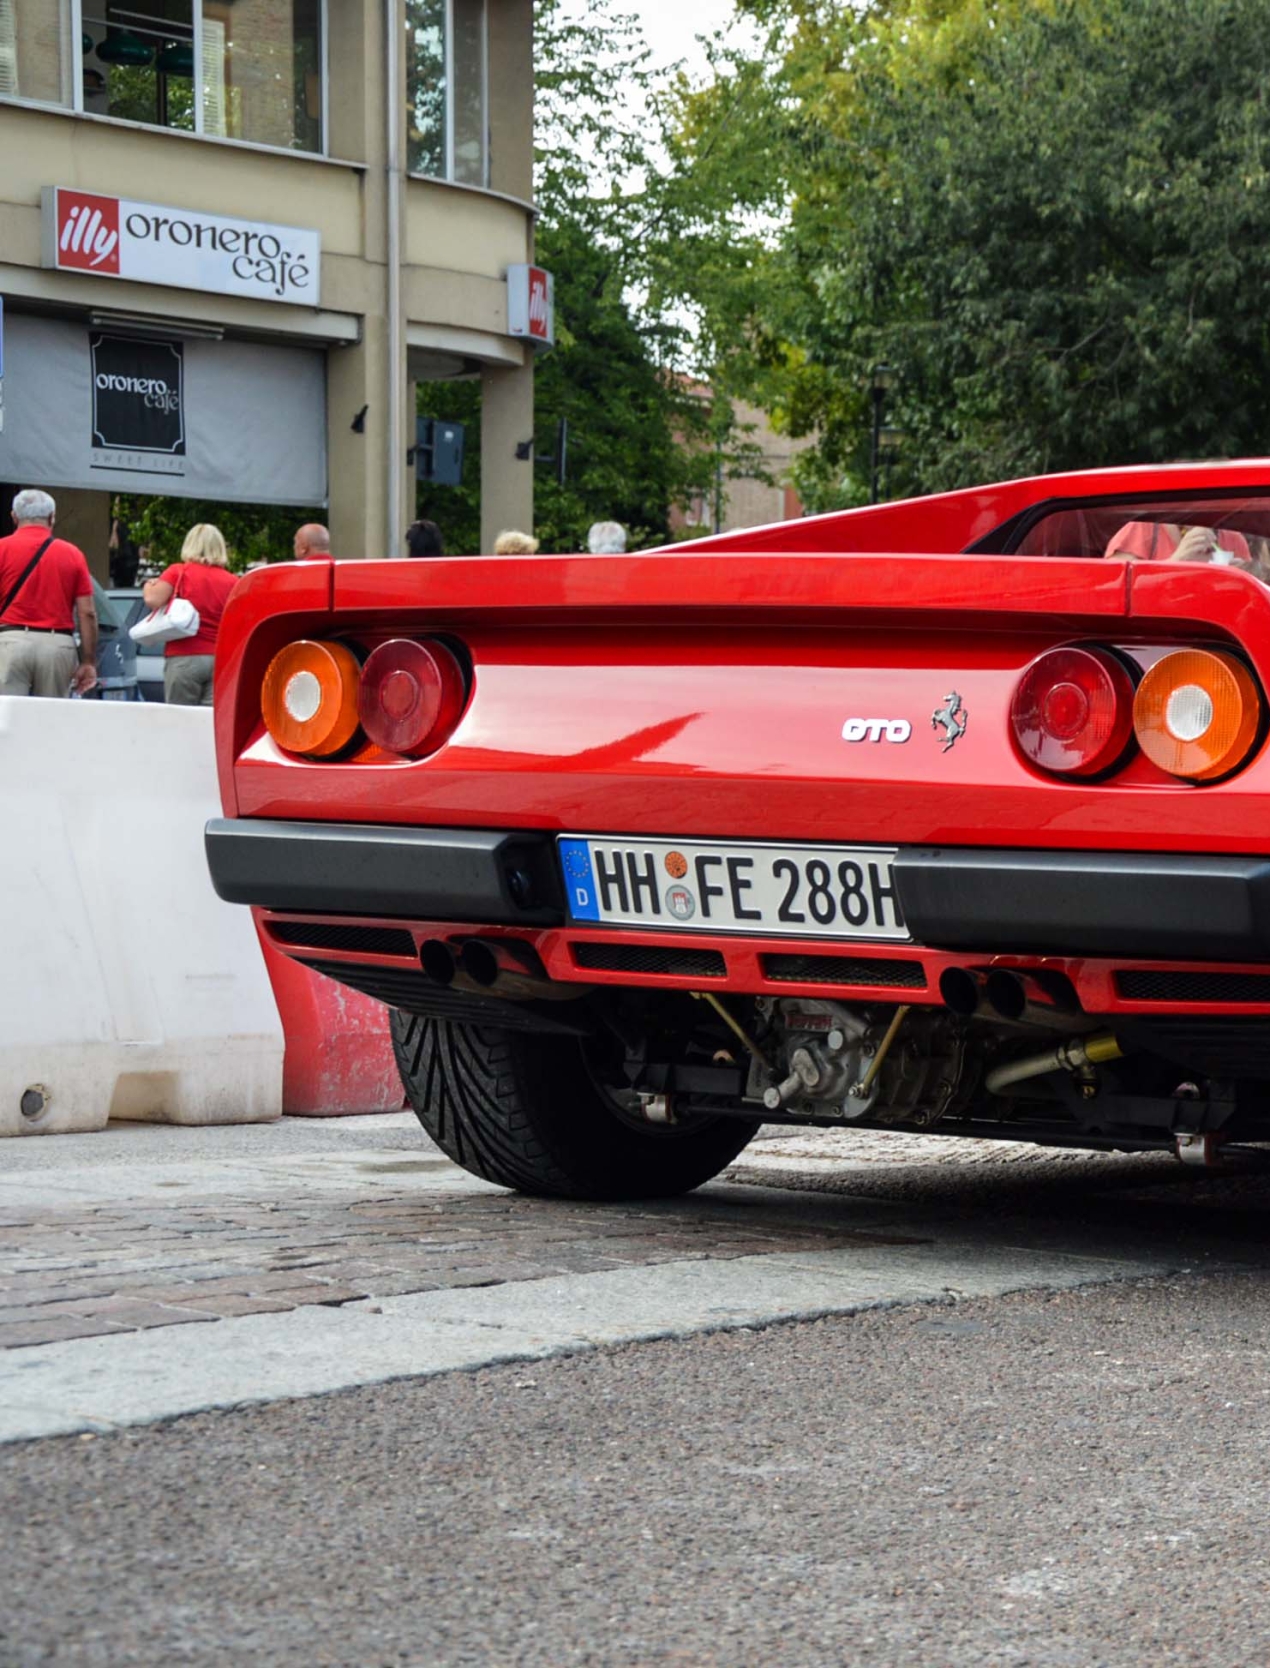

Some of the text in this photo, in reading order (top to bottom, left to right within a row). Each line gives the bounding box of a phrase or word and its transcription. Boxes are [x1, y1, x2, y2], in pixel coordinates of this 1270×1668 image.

[60, 206, 117, 266] illy
[126, 213, 281, 259] oronero
[232, 252, 309, 295] café
[96, 373, 167, 395] oronero
[144, 389, 179, 415] café
[842, 718, 912, 743] GTO
[575, 887, 589, 906] D
[594, 849, 905, 928] HH FE 288H
